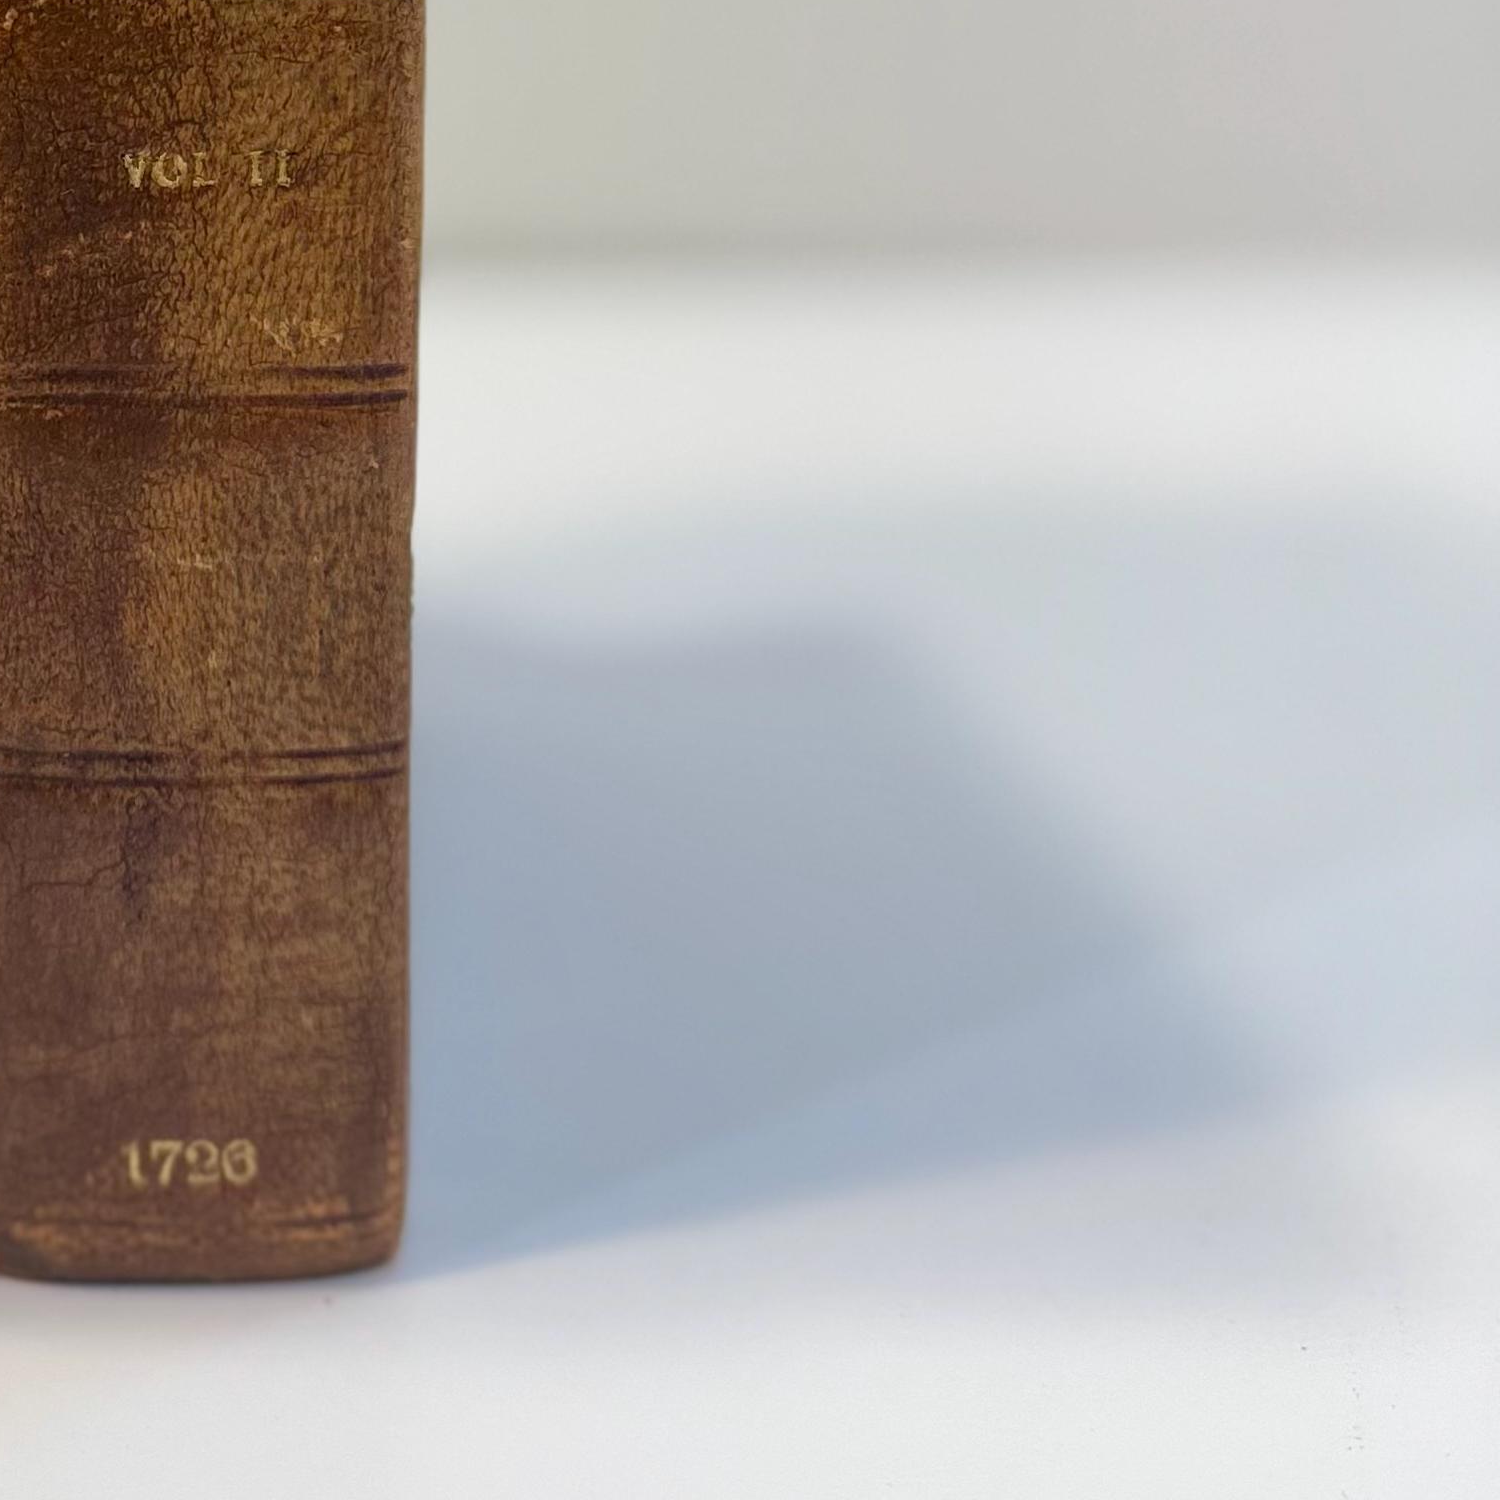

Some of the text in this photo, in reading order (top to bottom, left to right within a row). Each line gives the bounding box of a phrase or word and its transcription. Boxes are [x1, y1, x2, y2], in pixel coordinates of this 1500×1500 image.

[121, 148, 295, 189] VOL II
[120, 1138, 258, 1188] 1726
